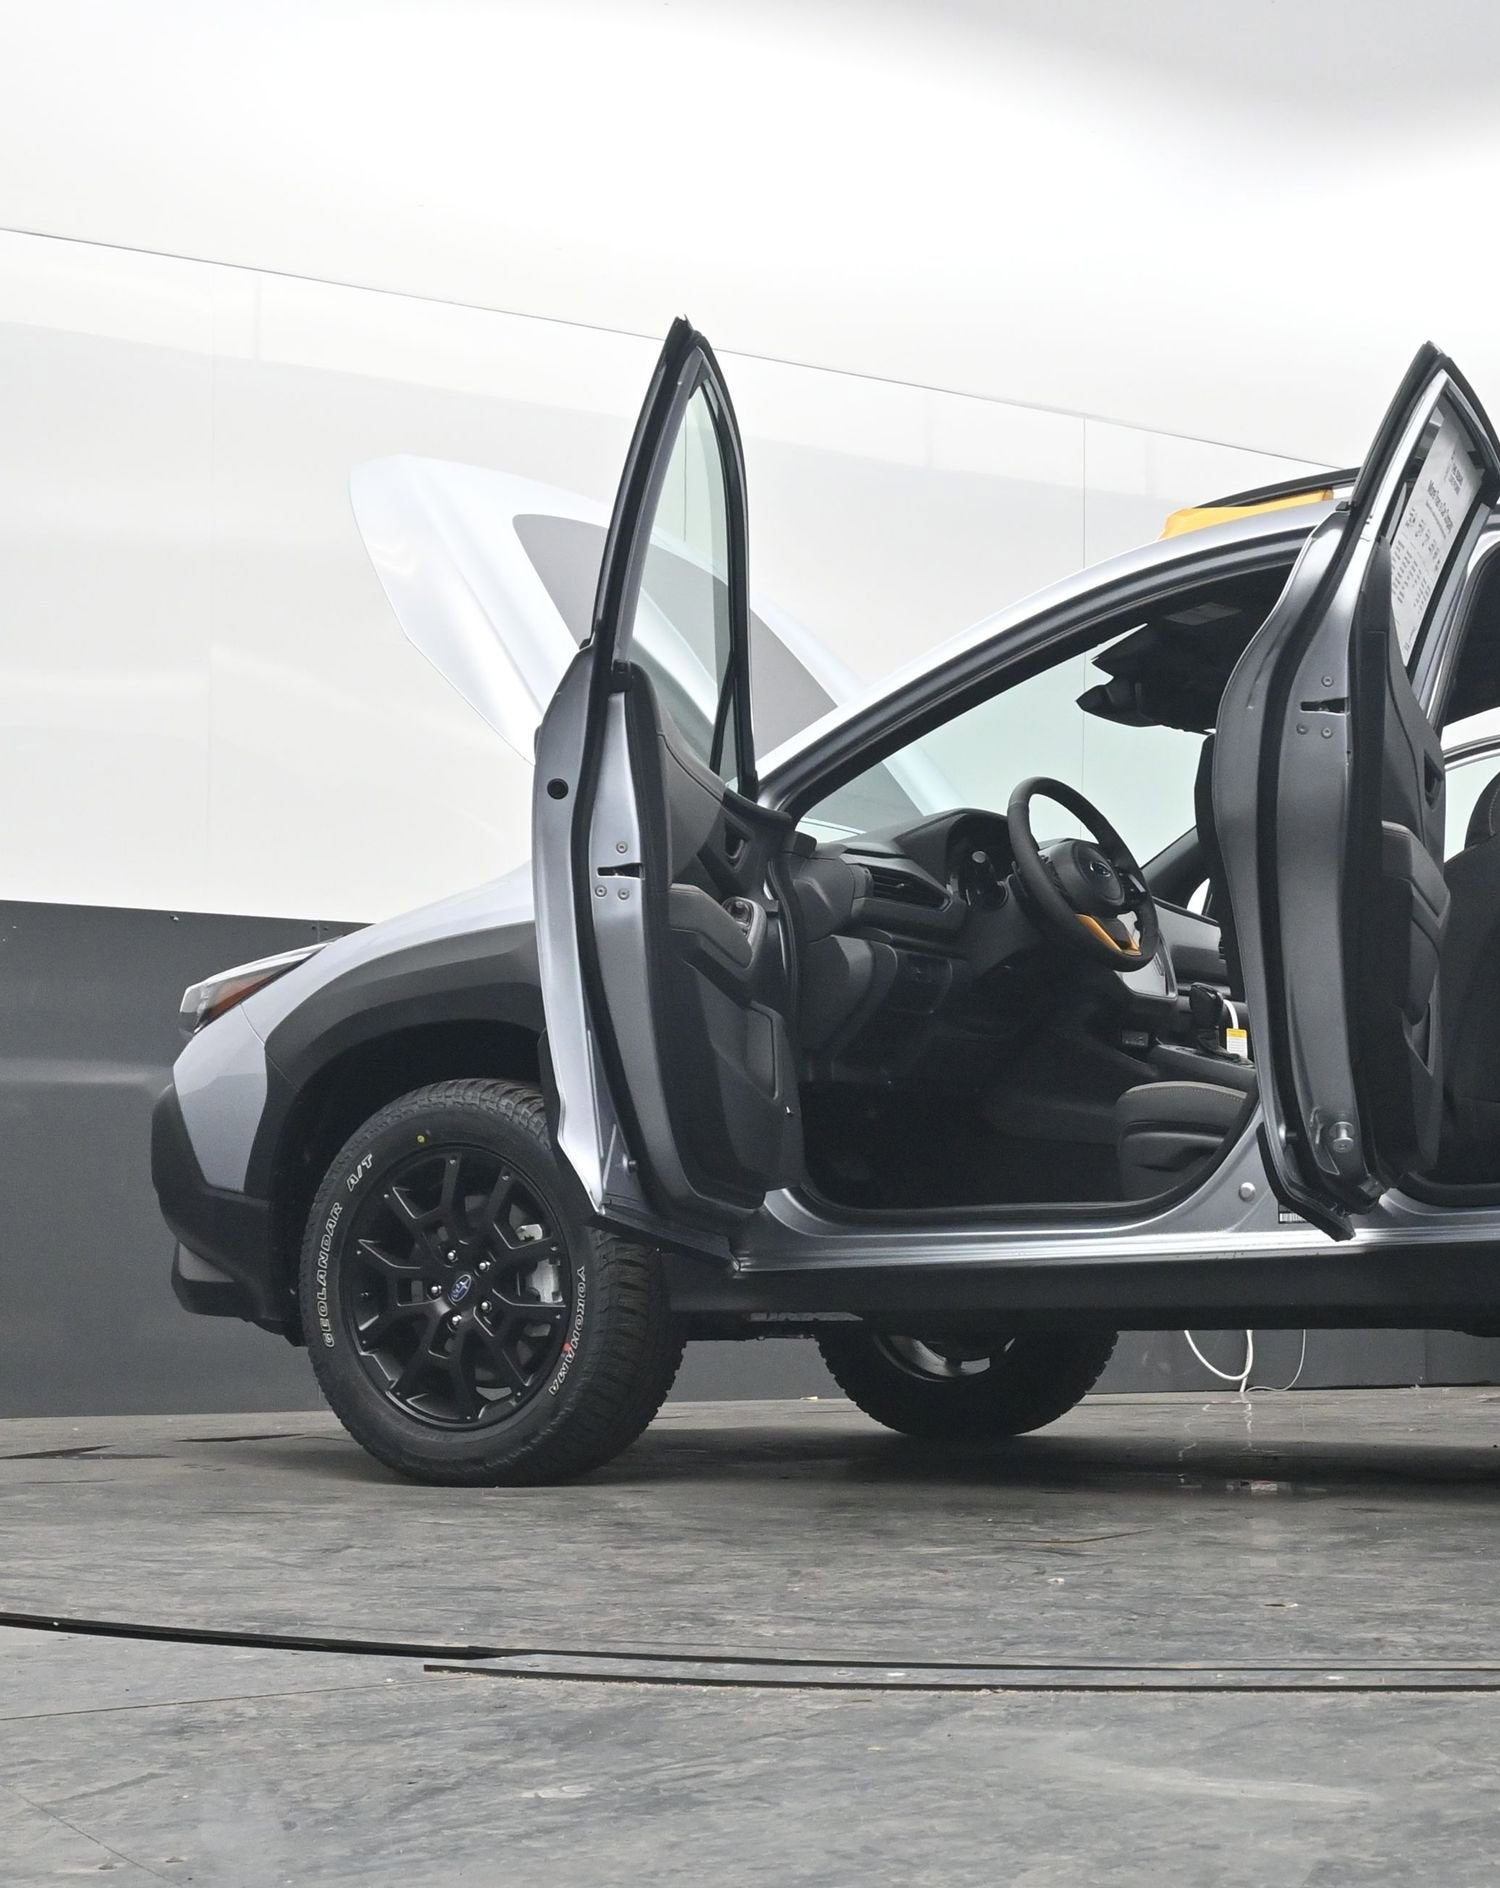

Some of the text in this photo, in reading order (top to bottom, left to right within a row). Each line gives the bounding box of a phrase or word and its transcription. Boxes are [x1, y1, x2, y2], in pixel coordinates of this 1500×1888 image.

[317, 1153, 373, 1347] GEOLANDAR A/T
[548, 1266, 586, 1395] YOKOHAMA
